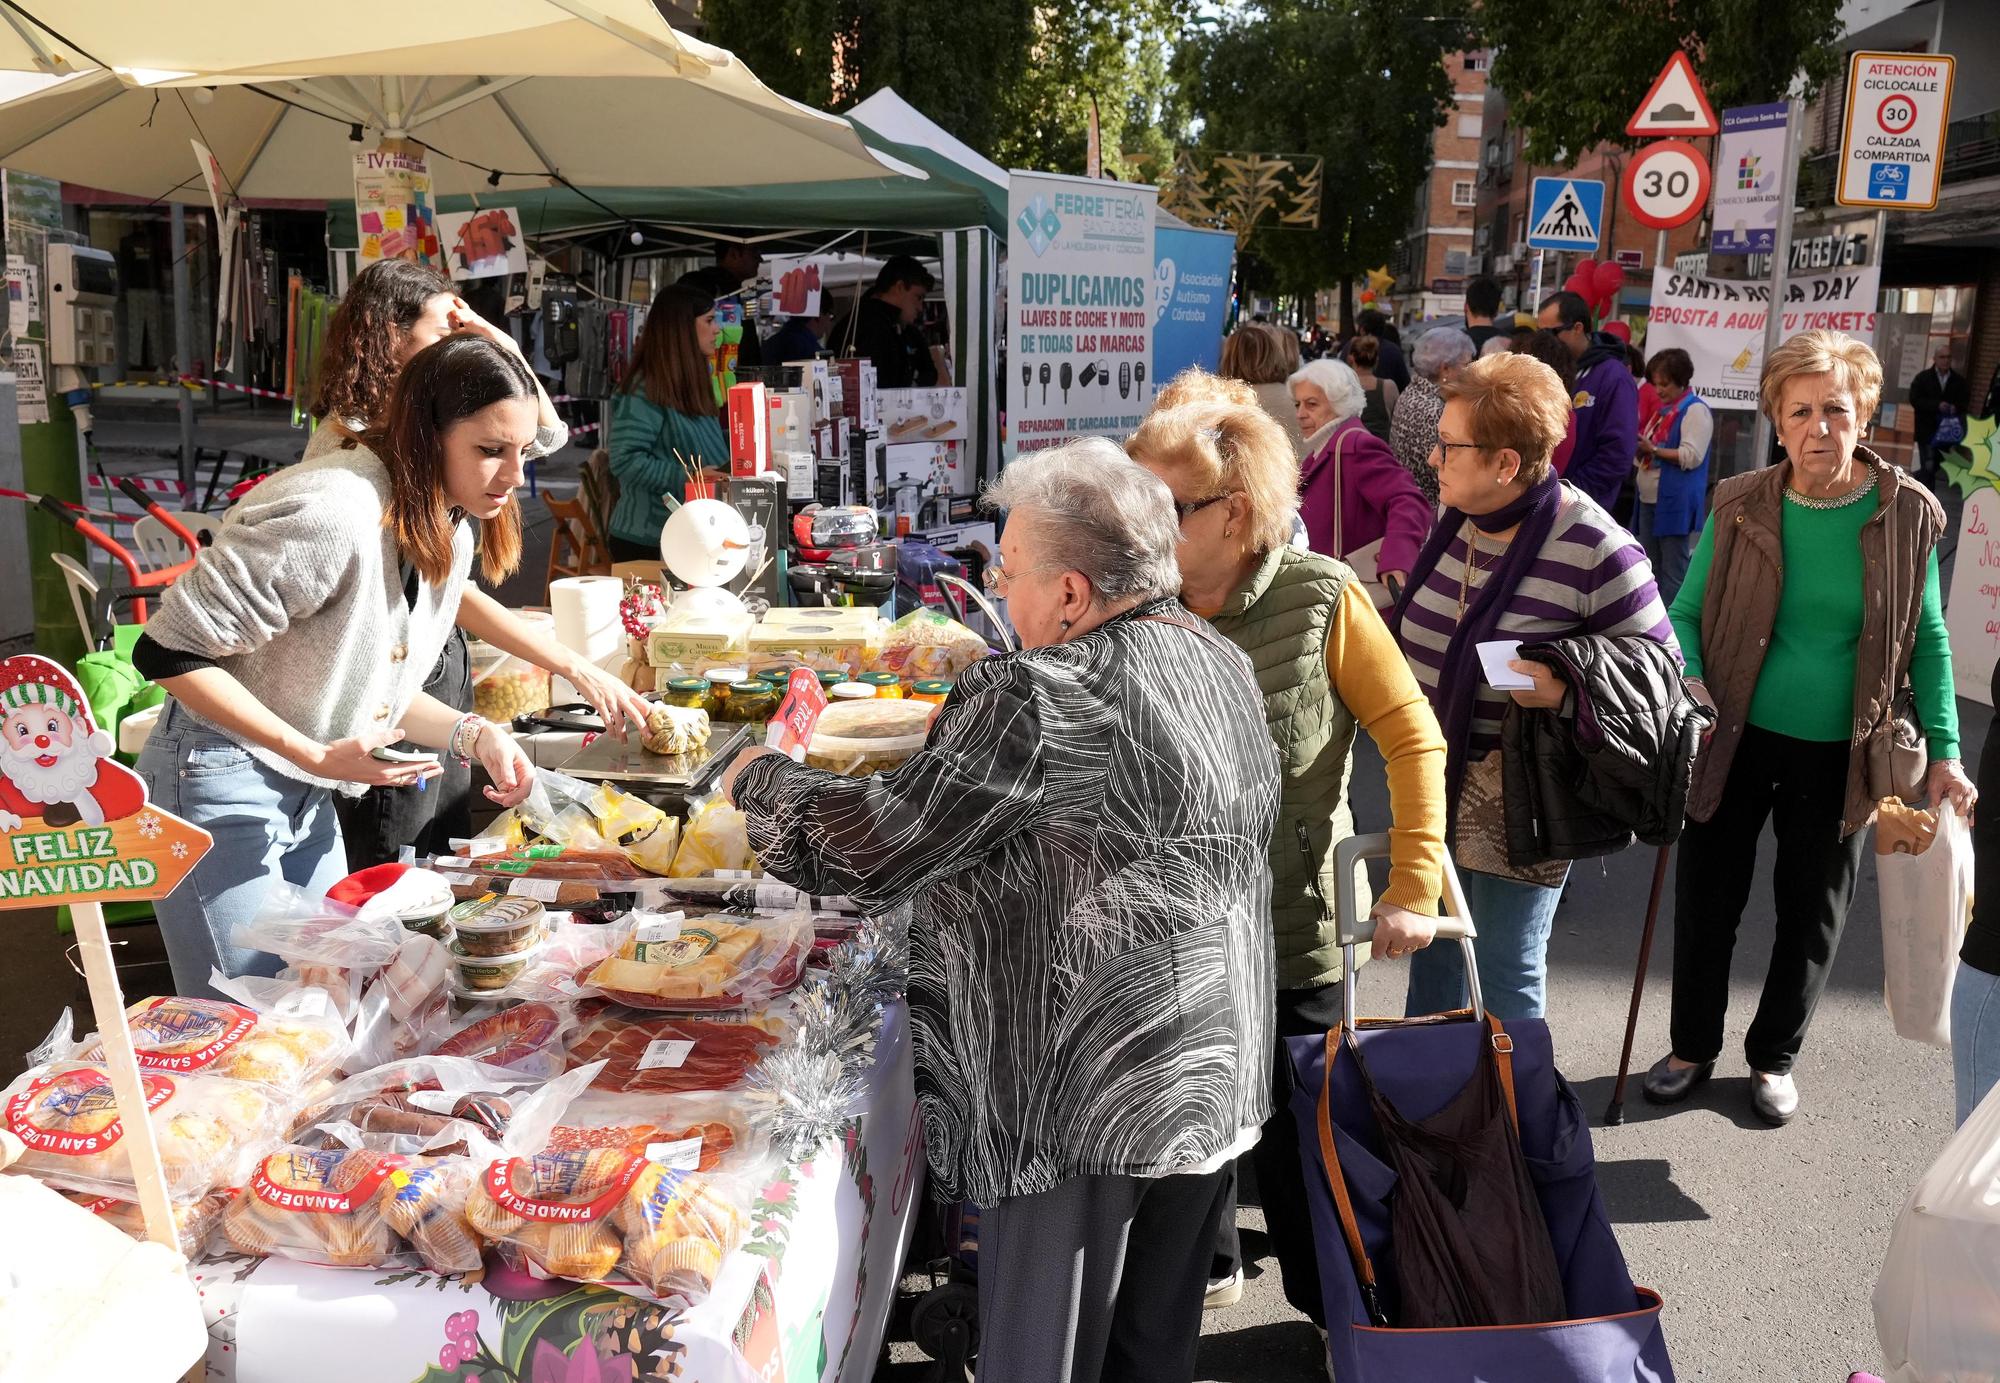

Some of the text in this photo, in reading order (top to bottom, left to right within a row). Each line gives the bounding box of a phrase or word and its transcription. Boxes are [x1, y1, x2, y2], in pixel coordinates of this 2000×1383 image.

[1868, 63, 1937, 77] ATENCIÓN
[1864, 80, 1938, 92] CICLOCALLE
[1759, 113, 1775, 122] Santa
[1886, 108, 1908, 121] 30
[1867, 136, 1921, 148] CALZADA
[367, 152, 385, 168] IV
[1854, 149, 1931, 163] COMPARTIDA
[1642, 170, 1690, 198] 30
[1746, 195, 1764, 203] SANTA
[1765, 194, 1781, 202] ROSA
[1055, 194, 1145, 220] FERRETERÍA
[1180, 272, 1223, 287] Asociación
[1021, 272, 1145, 307] DUPLICAMOS
[1665, 274, 1860, 303] SANTA ROA DAY
[1176, 290, 1211, 304] Autismo
[1021, 309, 1145, 328] LLAVES DE COCHE Y MOTO
[1171, 307, 1206, 322] Córdoba
[1648, 305, 1717, 328] DEPOSITA
[1724, 309, 1768, 329] AQUÍ
[1802, 311, 1876, 331] TICKETS
[1021, 335, 1145, 353] DE TODAS LAS MARCAS
[1018, 419, 1065, 433] REPARACION
[1067, 418, 1076, 431] DE
[1079, 416, 1119, 430] CARCASAS
[1979, 539, 2000, 568] Na
[11, 828, 116, 864] FELIZ
[0, 859, 156, 898] NAVIDAD
[158, 1056, 192, 1071] SAN
[59, 1138, 97, 1151] SAN
[255, 1175, 350, 1211] PANADERÍA
[498, 1187, 592, 1220] PANADERÍA
